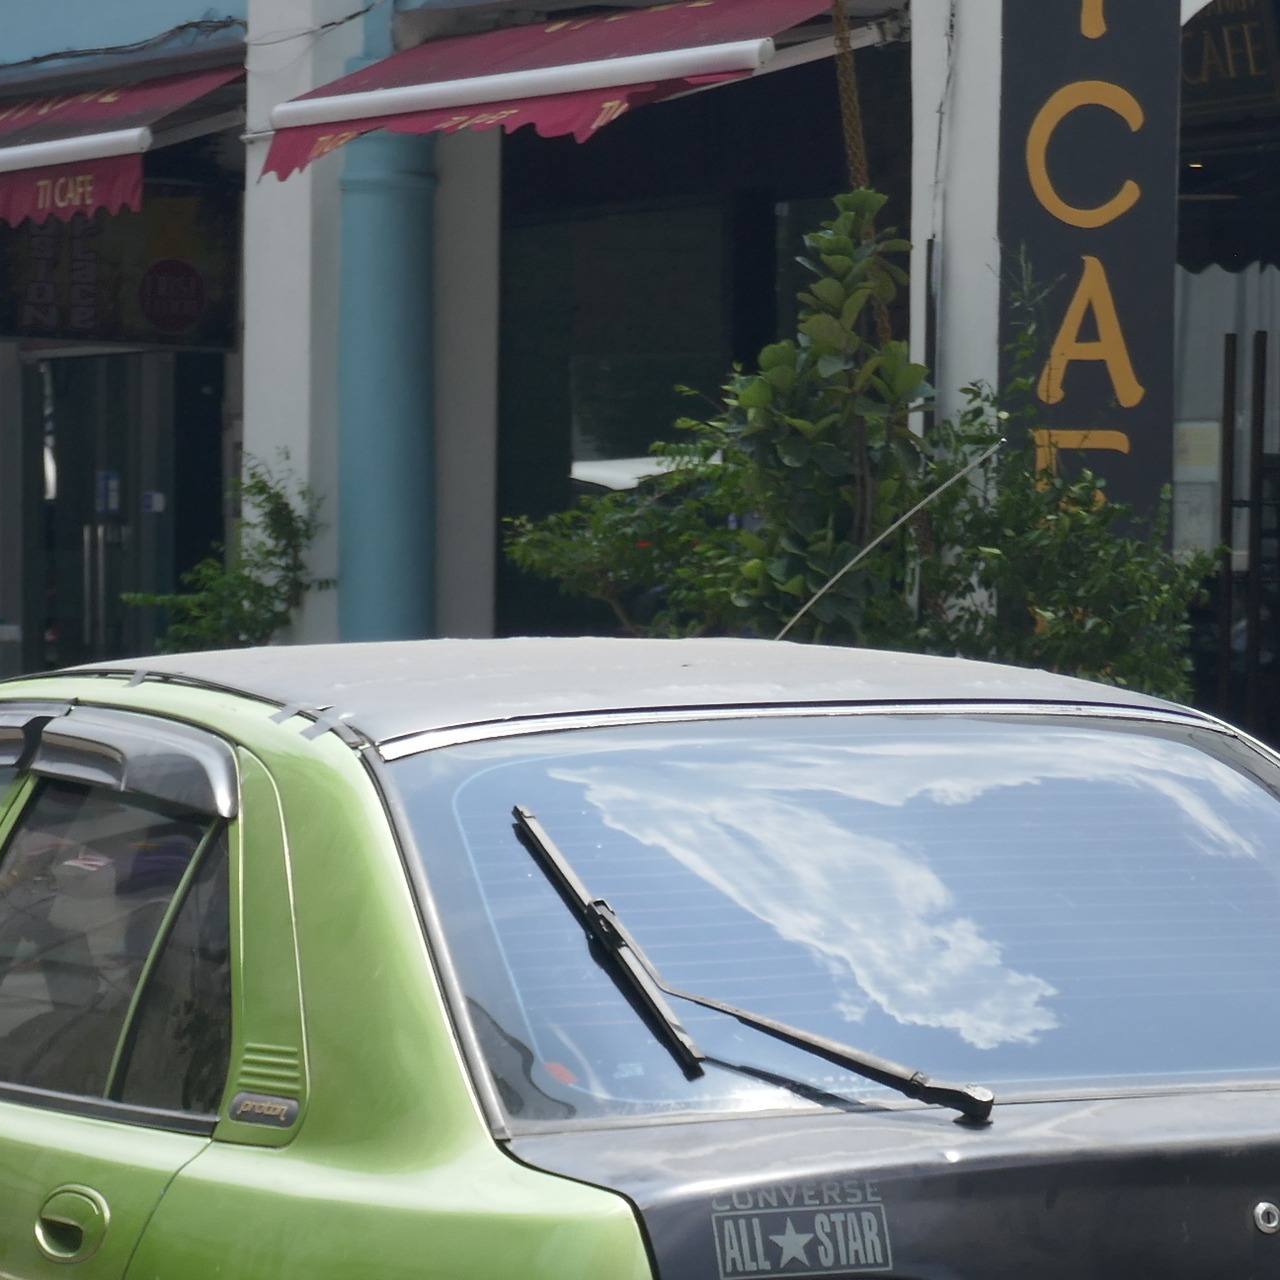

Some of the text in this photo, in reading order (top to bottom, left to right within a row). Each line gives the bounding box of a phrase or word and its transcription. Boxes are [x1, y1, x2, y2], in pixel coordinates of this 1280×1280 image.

[54, 175, 94, 208] CAFE
[712, 1178, 882, 1212] CONVERSE
[723, 1211, 884, 1274] ALL STAR
